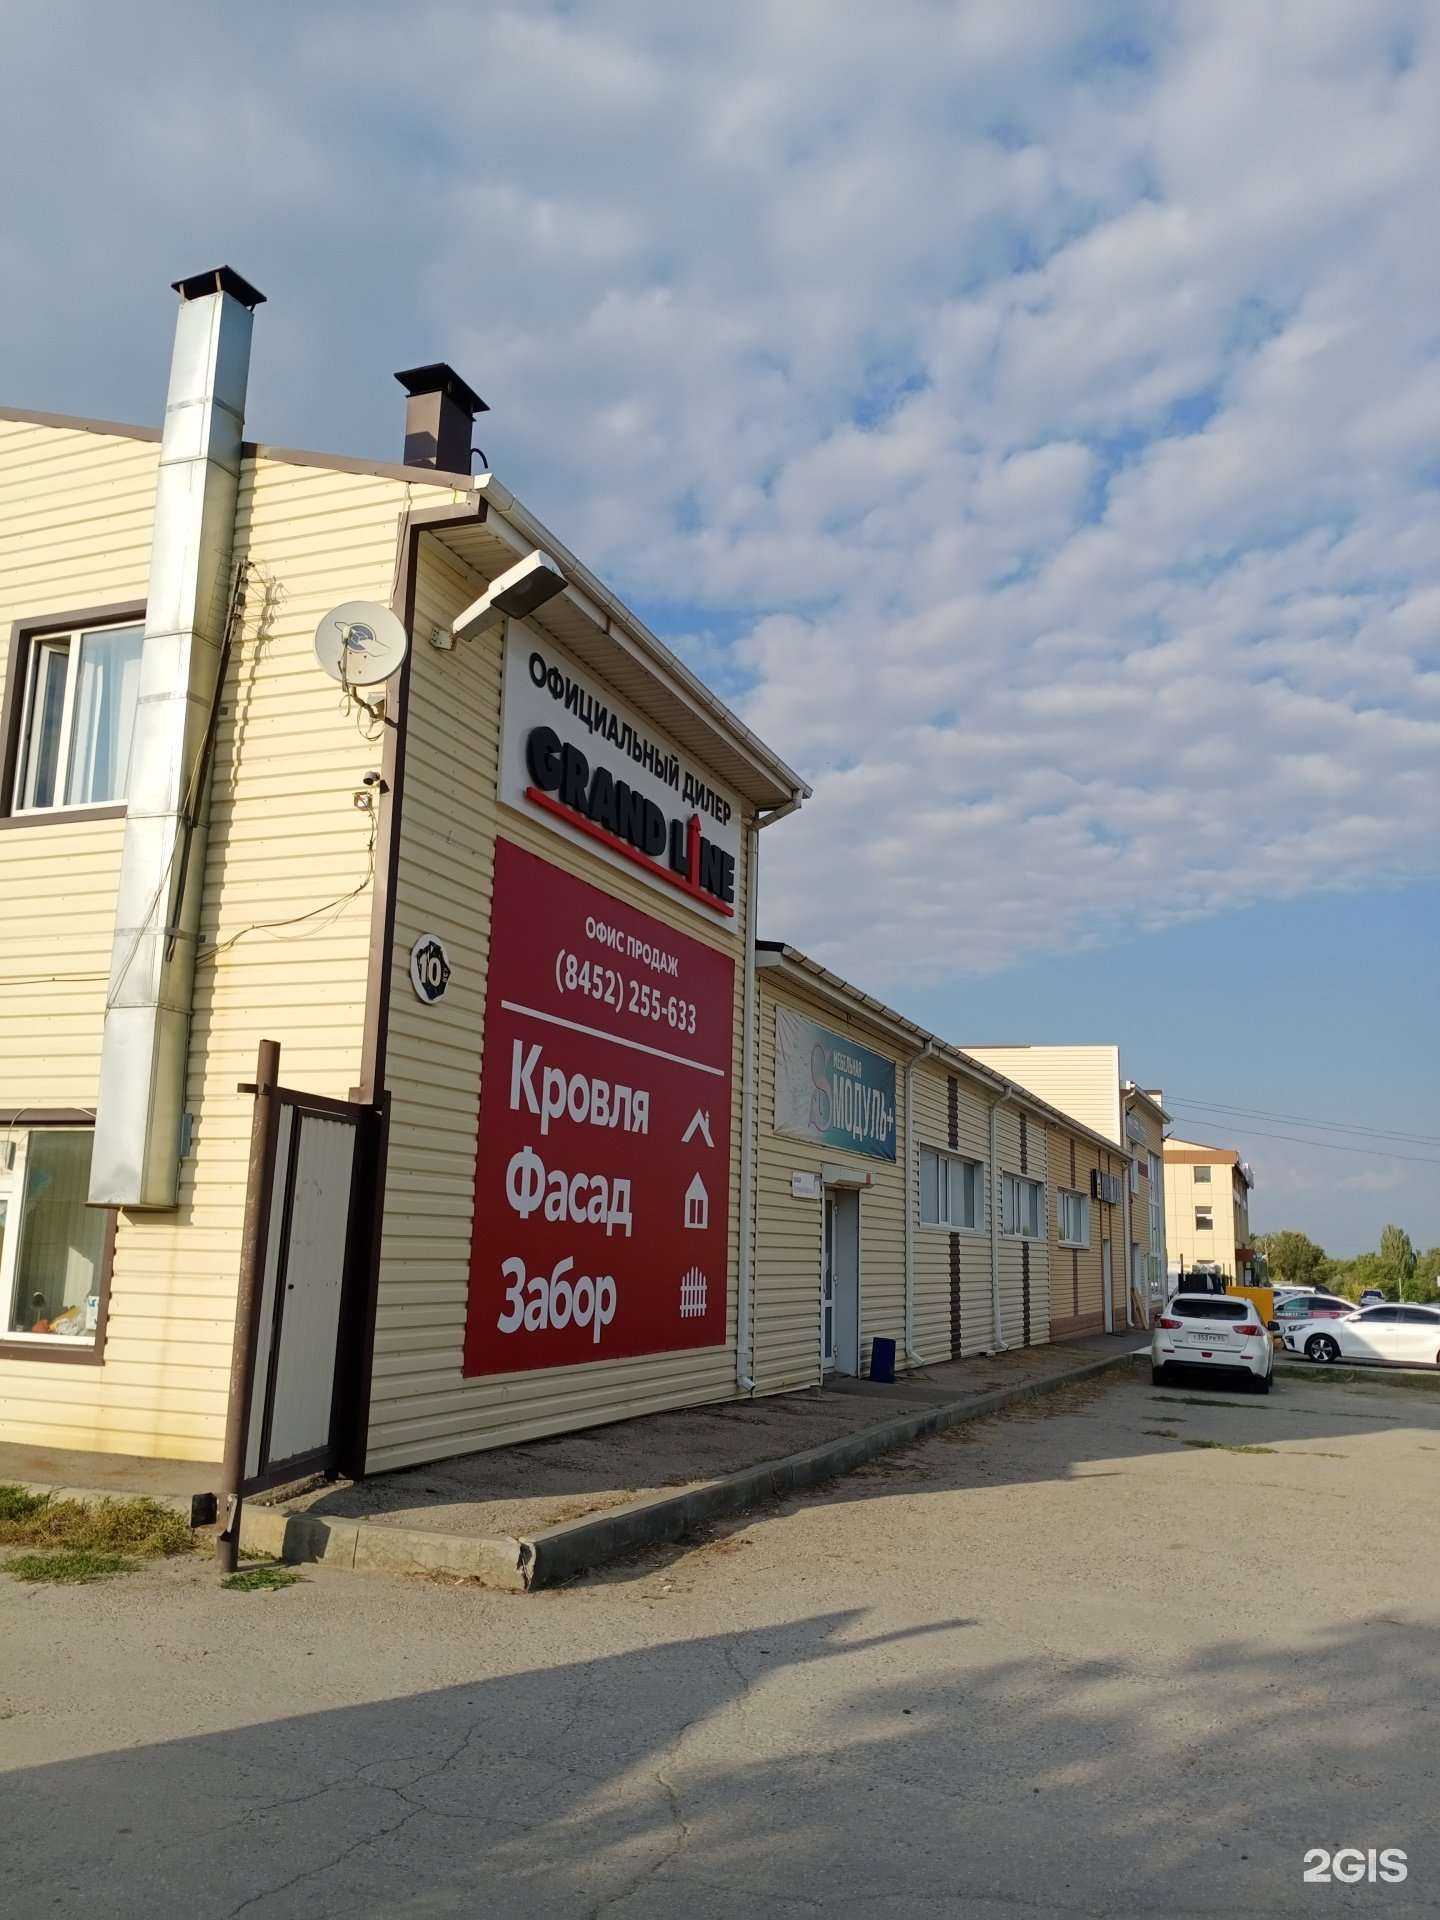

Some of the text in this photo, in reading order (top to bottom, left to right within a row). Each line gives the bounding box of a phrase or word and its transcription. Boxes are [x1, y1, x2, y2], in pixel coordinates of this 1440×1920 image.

[529, 652, 731, 826] ОФИЦИАЛЬНЫЙ ДИЛЕР
[527, 726, 735, 903] GRAND LINE
[420, 953, 441, 987] 10
[555, 949, 696, 1034] (8452) 255-633
[585, 916, 679, 978] ОФИС ПРОДАЖ
[510, 1039, 650, 1135] Кровля
[506, 1146, 632, 1237] Фасад
[497, 1256, 617, 1344] Забор
